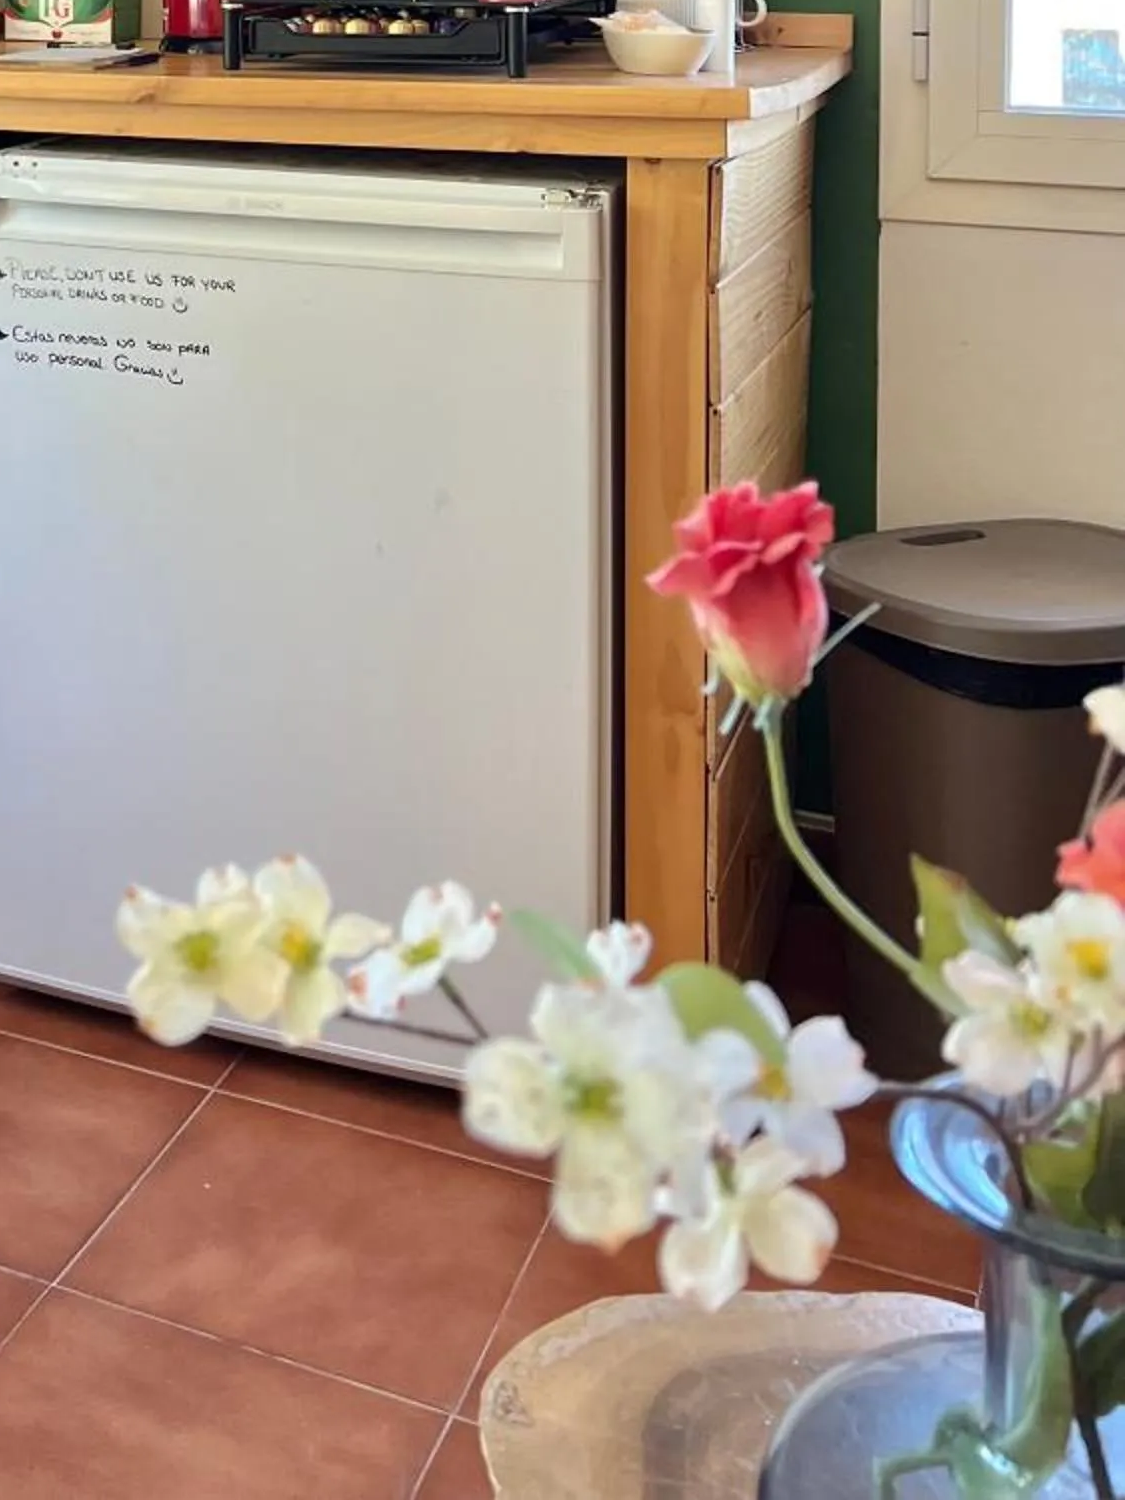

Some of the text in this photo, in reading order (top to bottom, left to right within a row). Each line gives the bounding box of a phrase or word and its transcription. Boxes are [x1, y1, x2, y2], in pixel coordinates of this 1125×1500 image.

[109, 269, 136, 283] USE
[145, 273, 163, 287] US
[171, 275, 196, 289] FOR
[201, 278, 236, 293] YOUR
